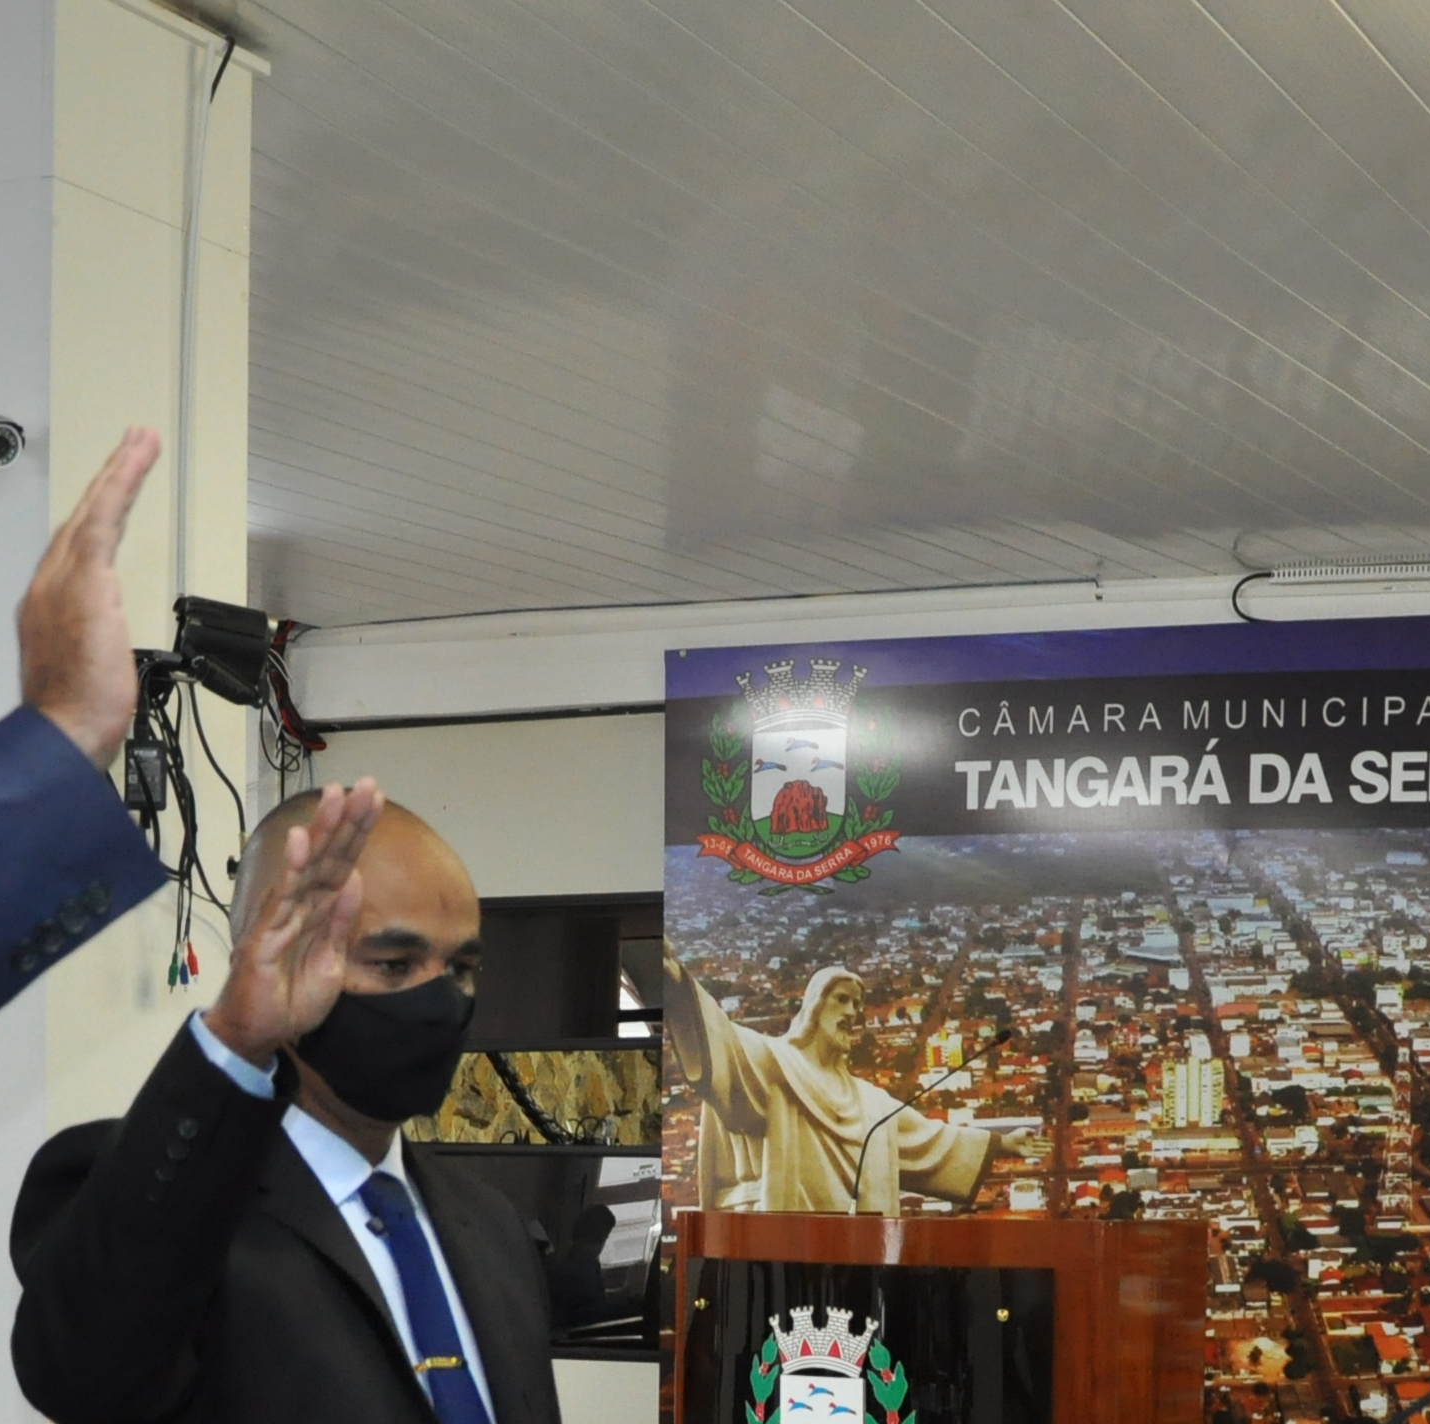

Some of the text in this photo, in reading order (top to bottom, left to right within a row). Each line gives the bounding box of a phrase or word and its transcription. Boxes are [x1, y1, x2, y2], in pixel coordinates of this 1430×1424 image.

[958, 701, 1162, 737] CÂMARA
[955, 738, 1231, 810] TANGARÁ
[1250, 752, 1333, 804] DA
[864, 834, 891, 851] 1976
[796, 870, 812, 880] DA
[814, 847, 853, 877] SERRA
